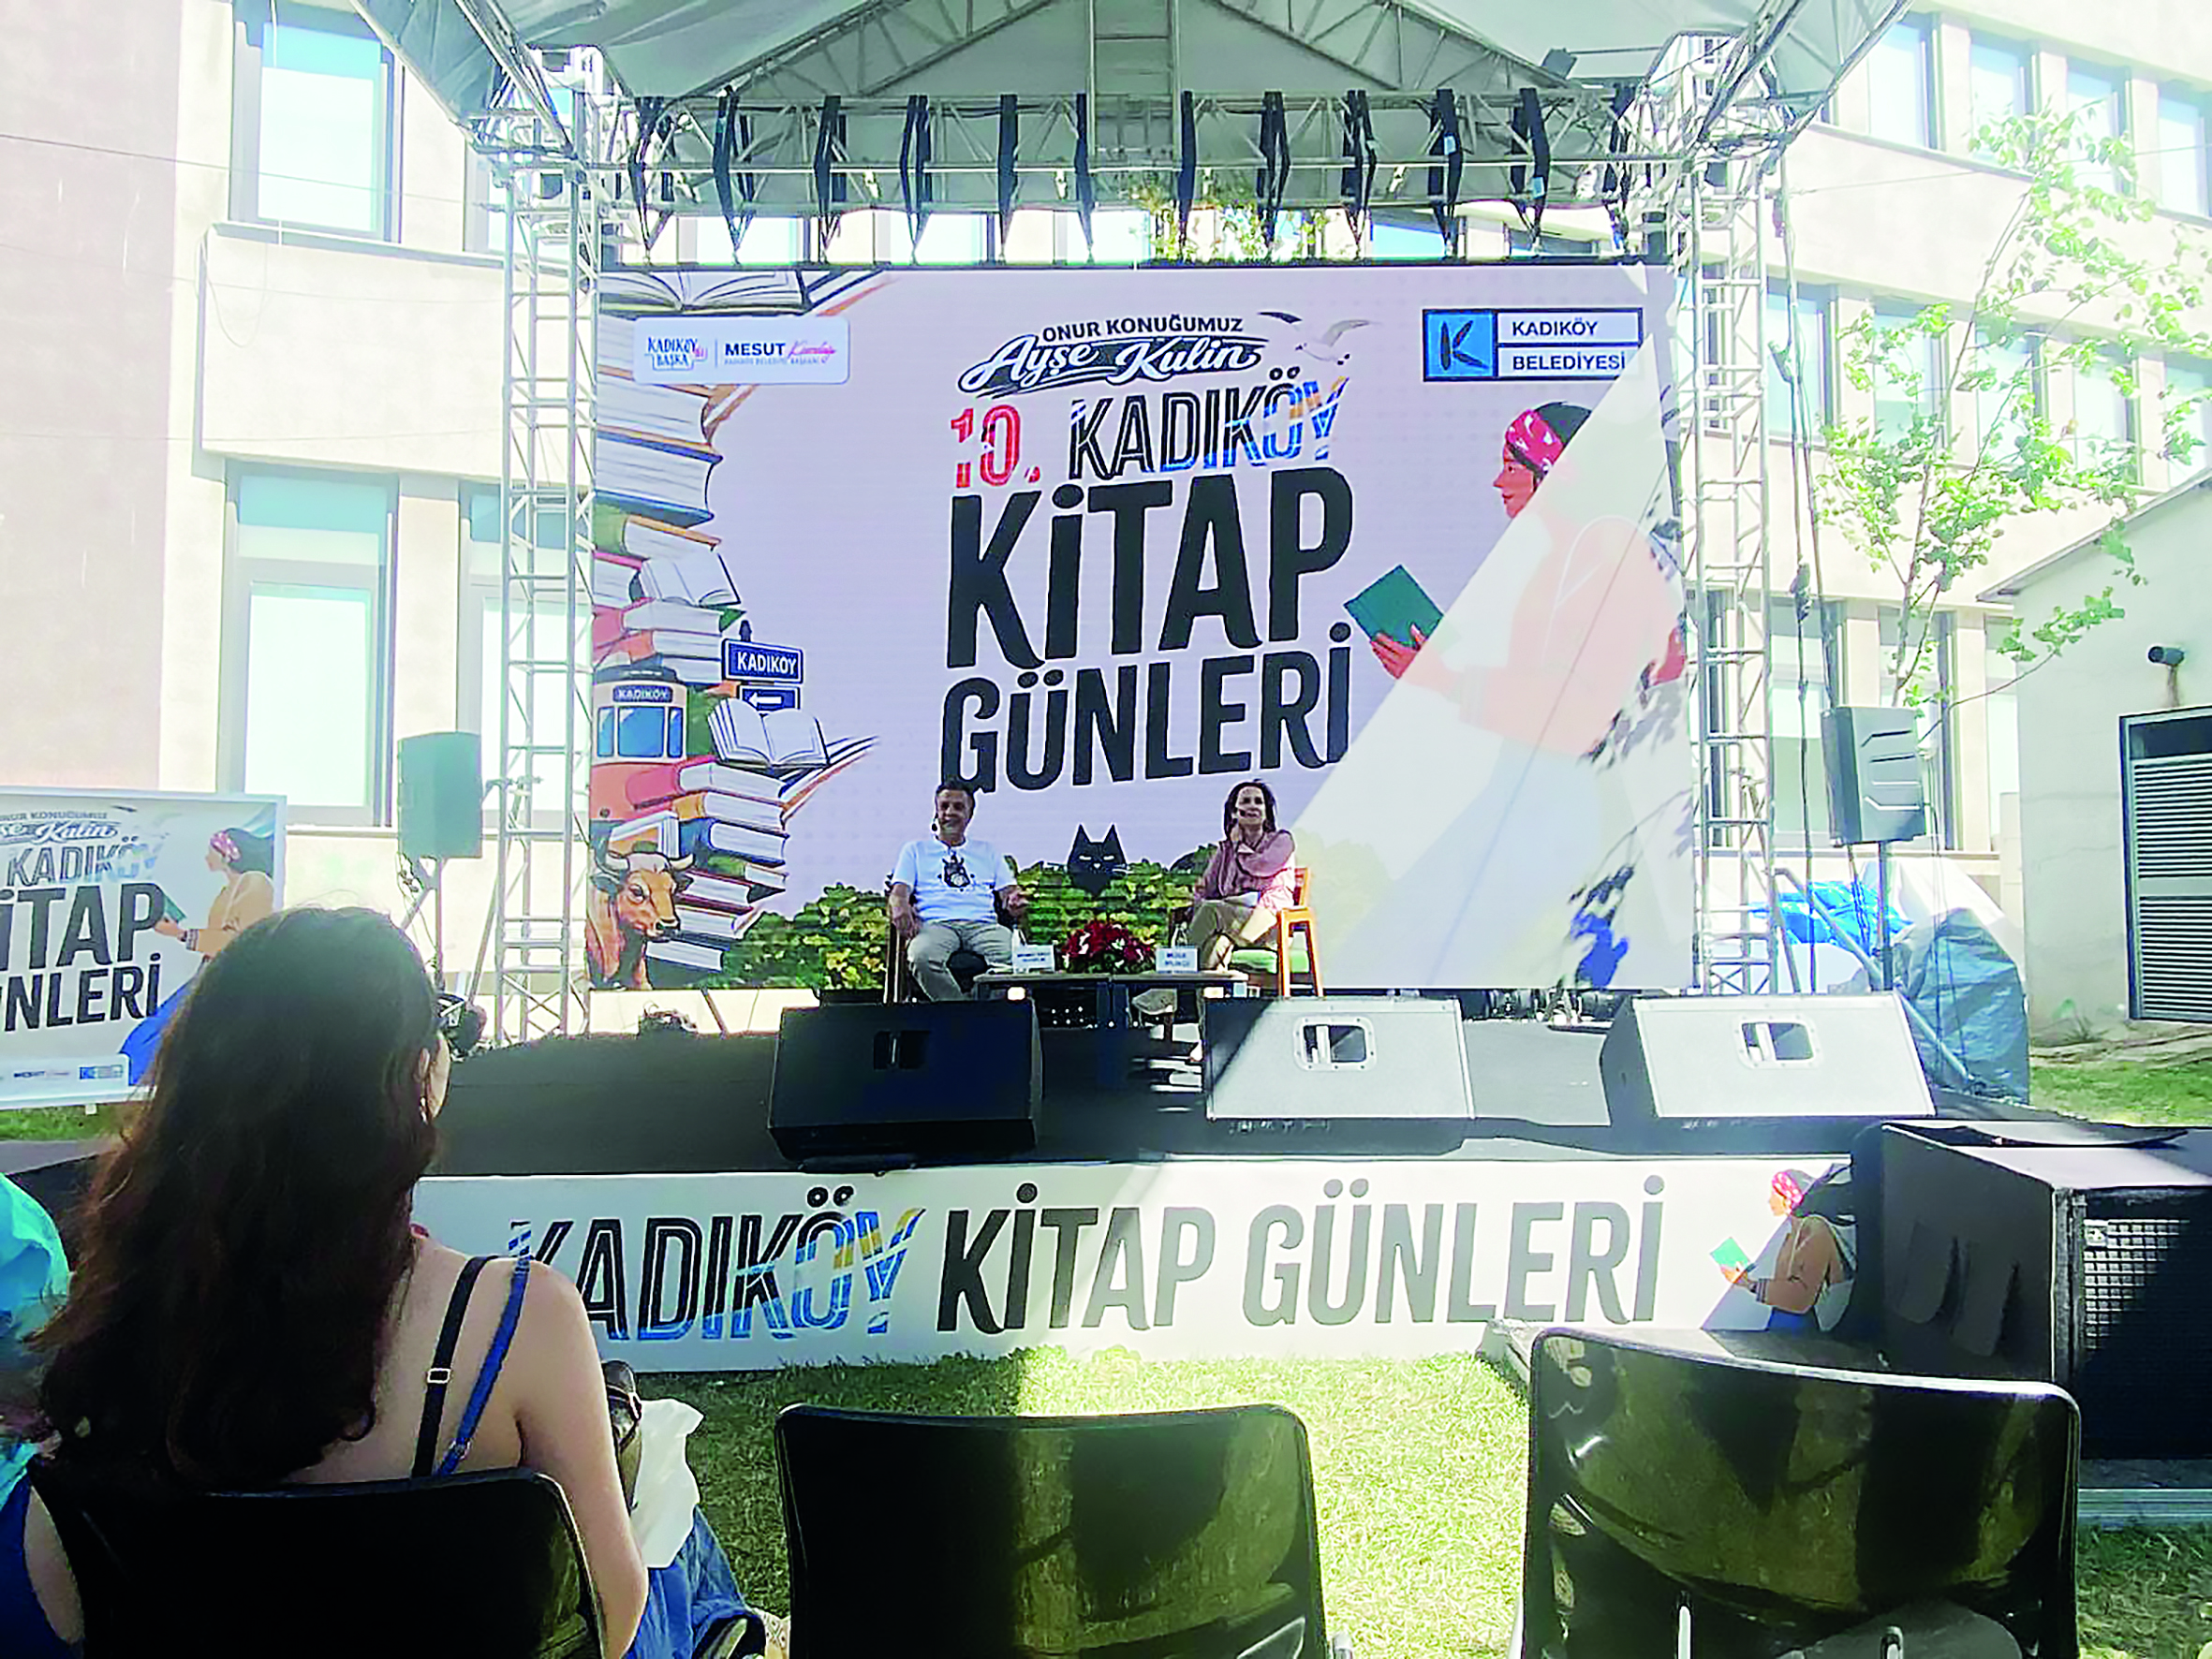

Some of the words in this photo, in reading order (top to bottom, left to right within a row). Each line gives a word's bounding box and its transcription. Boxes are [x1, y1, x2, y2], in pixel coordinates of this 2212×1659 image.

[725, 343, 786, 356] MESUT
[1042, 322, 1100, 342] ONUR
[1106, 315, 1244, 335] KONUĞUMUZ
[1512, 317, 1599, 337] KADIKÖY
[1512, 351, 1626, 371] BELEDİYESİ
[958, 334, 1100, 392] Ayşe
[1106, 335, 1261, 386] Kulin
[1069, 365, 1350, 480] KADIKÖY
[946, 466, 1353, 670] KİTAP
[940, 622, 1352, 793] GÜNLERİ
[0, 953, 161, 1032] NLERİ
[936, 1183, 1216, 1335] KİTAP
[1242, 1175, 1664, 1327] GÜNLERİ
